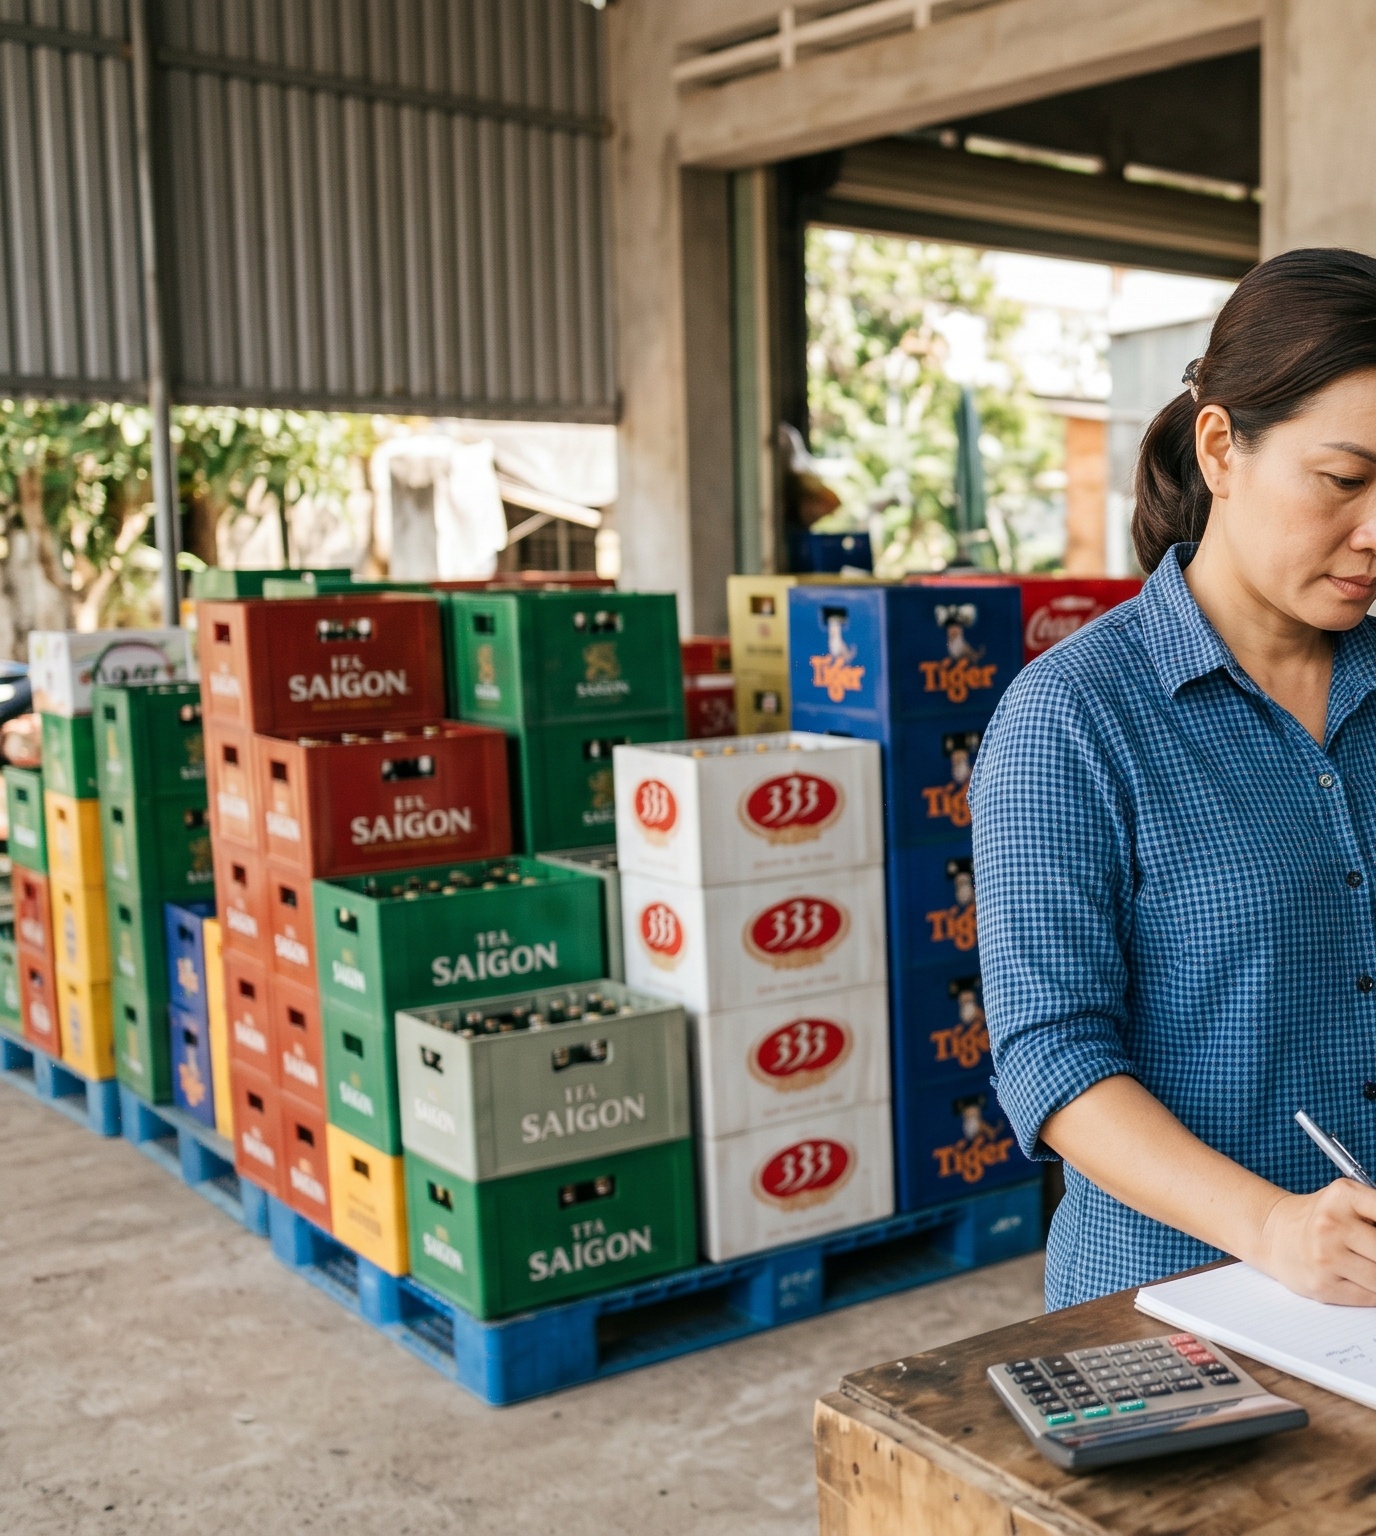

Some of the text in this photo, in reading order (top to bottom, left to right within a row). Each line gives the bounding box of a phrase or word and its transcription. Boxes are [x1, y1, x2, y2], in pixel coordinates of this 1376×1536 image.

[289, 669, 408, 702] SAIGON
[809, 654, 866, 703] Tiger
[919, 656, 998, 703] Tiger
[760, 776, 820, 824] 333
[921, 780, 972, 827] Tig
[350, 806, 474, 846] SAIGON
[766, 898, 824, 951] 333
[925, 903, 978, 952] Tig
[430, 940, 560, 987] SAIGON
[771, 1021, 828, 1072] 333
[929, 1020, 991, 1069] Tige
[520, 1094, 648, 1145] SAIGON
[776, 1141, 833, 1193] 333
[932, 1136, 1014, 1184] Tiger
[527, 1225, 654, 1283] SAIGON
